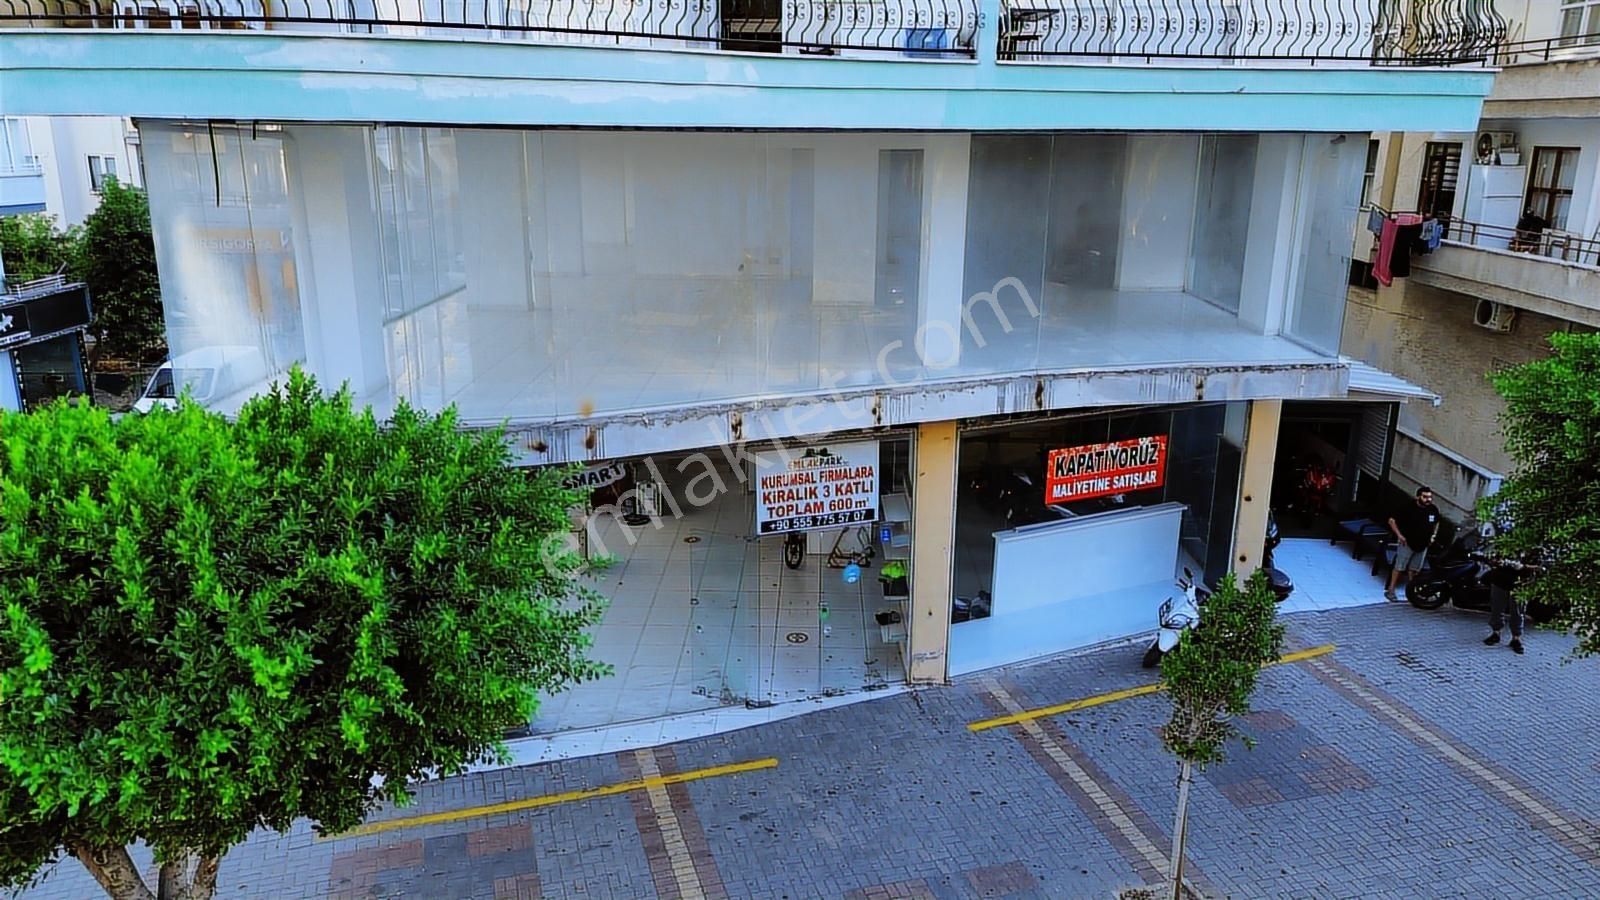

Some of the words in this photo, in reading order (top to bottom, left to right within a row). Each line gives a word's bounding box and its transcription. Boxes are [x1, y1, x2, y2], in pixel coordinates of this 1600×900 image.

[1054, 442, 1160, 479] KAPATIYORUZ
[761, 471, 817, 490] KURUMSAL
[823, 484, 831, 498] 3
[835, 479, 874, 497] KATLI
[1052, 475, 1111, 498] MALİYETİNE
[1112, 470, 1157, 489] SATIŞLAR
[767, 501, 825, 519] TOPLAM
[829, 497, 853, 511] 600
[769, 519, 790, 530] +90
[793, 517, 813, 529] 555
[816, 514, 835, 526] 775
[838, 512, 851, 523] 57
[853, 510, 867, 521] 07
